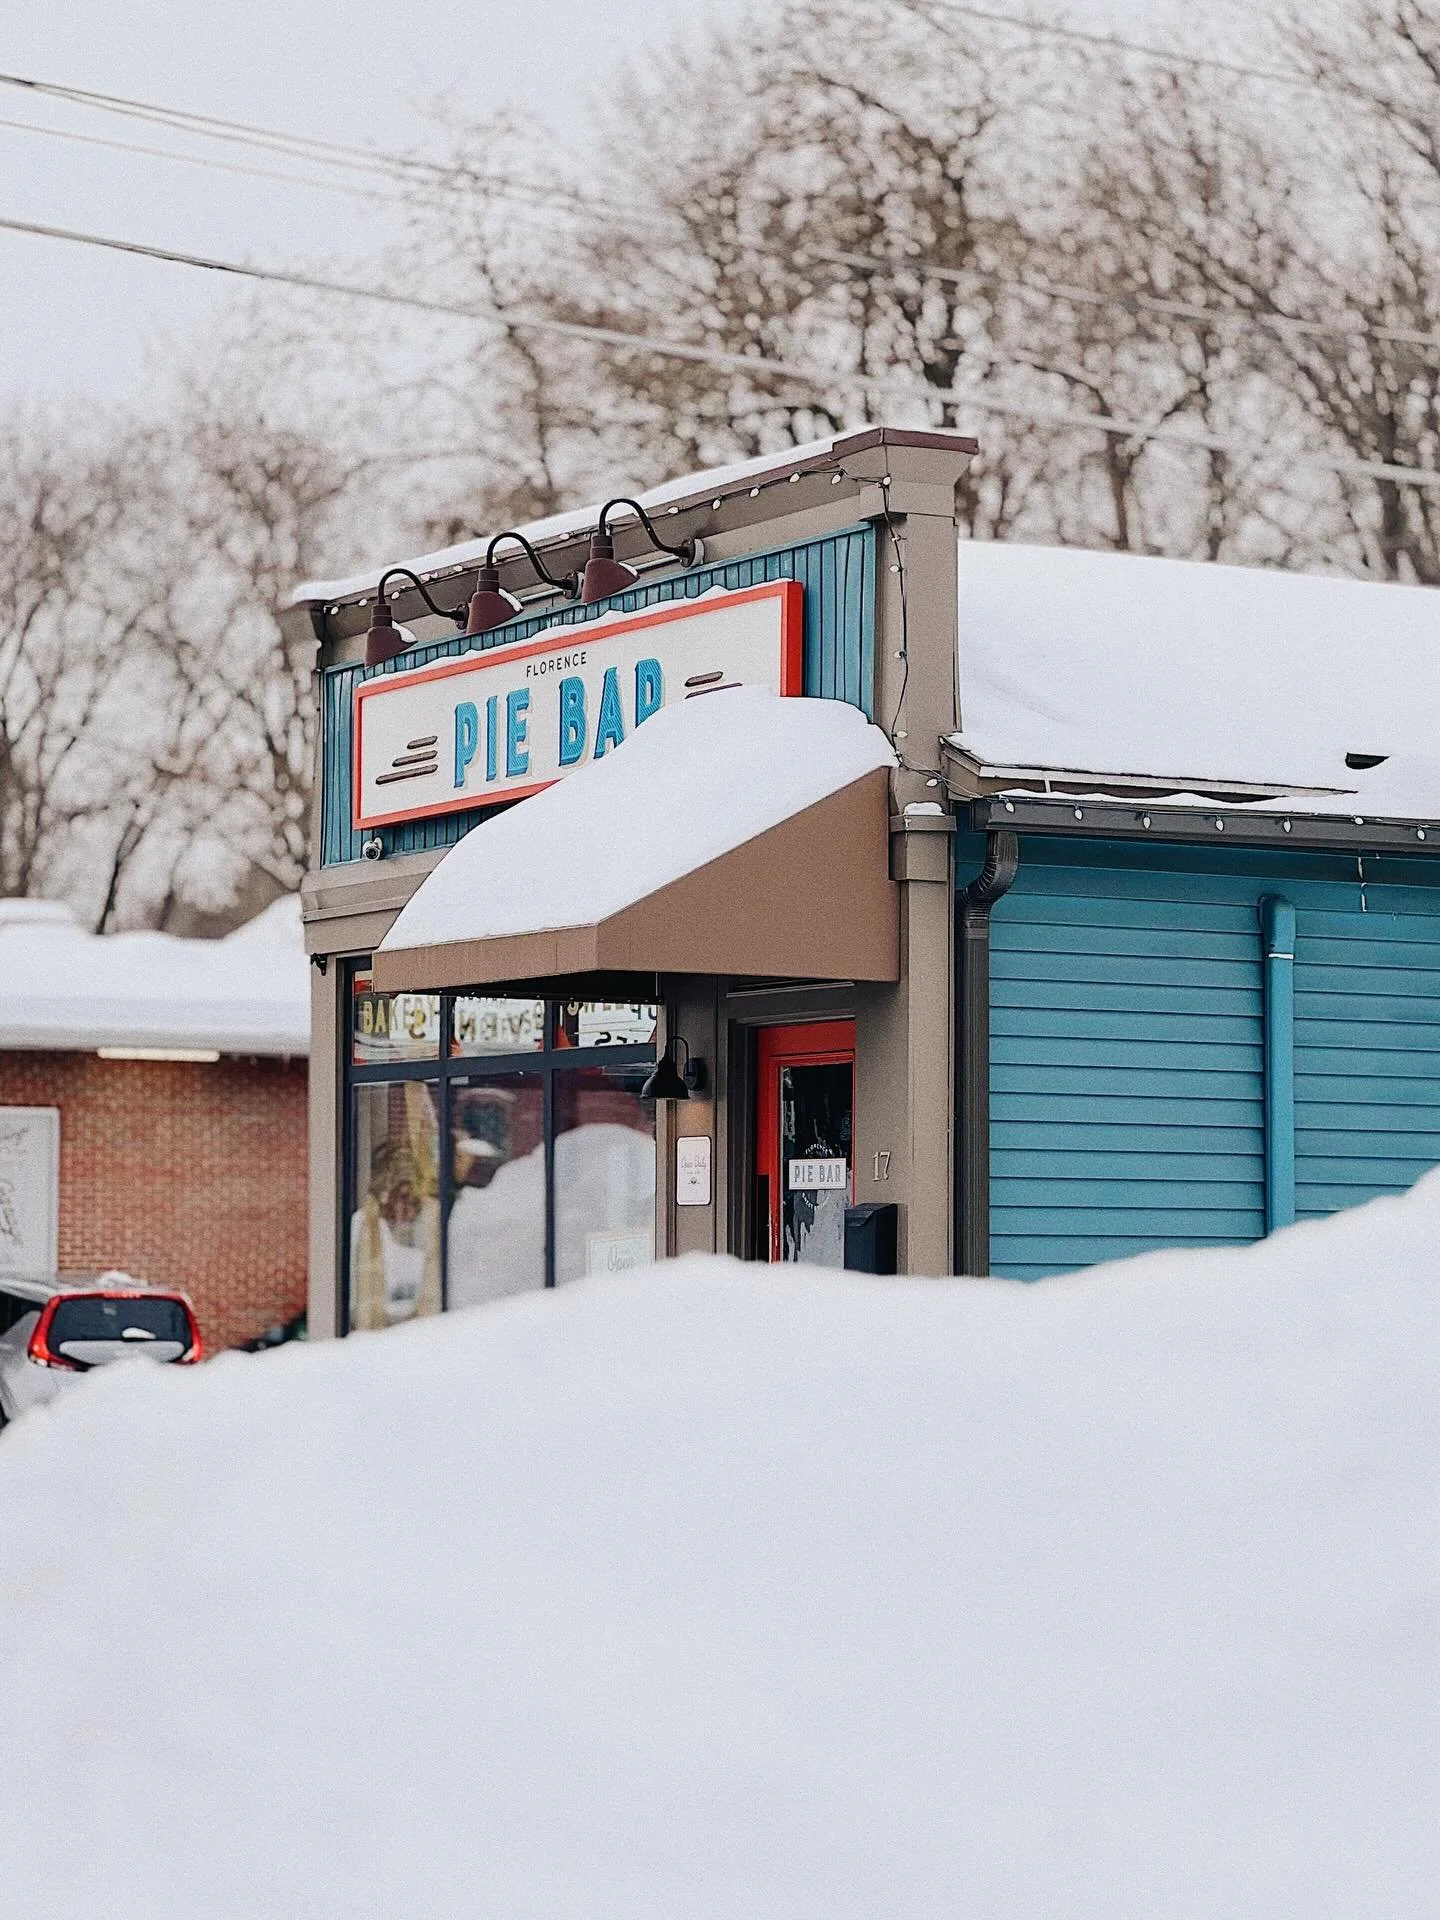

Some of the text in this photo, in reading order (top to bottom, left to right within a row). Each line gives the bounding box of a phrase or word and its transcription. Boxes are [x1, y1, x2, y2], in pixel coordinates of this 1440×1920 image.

[526, 651, 587, 677] FLORENCE
[454, 687, 531, 788] PIE
[794, 1164, 841, 1183] PIE BAR
[872, 1151, 892, 1182] 17
